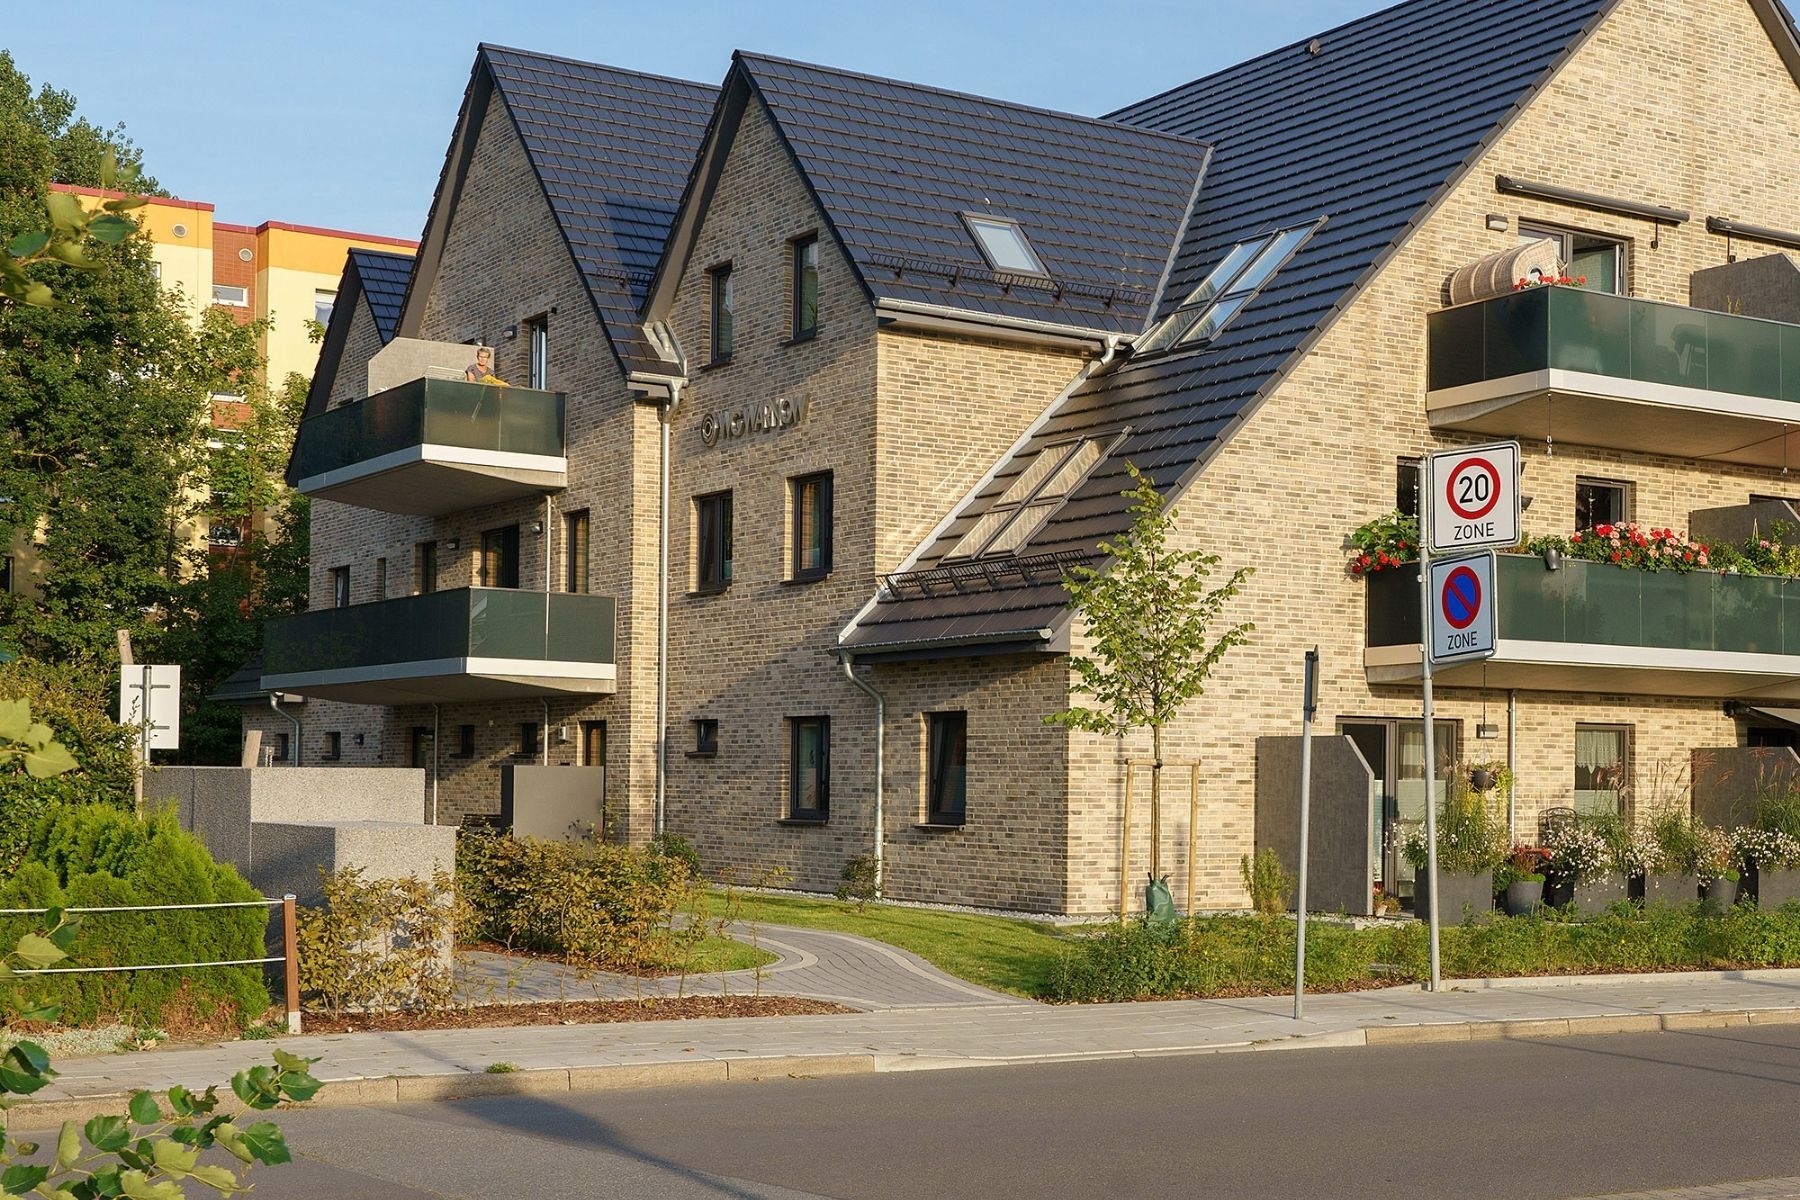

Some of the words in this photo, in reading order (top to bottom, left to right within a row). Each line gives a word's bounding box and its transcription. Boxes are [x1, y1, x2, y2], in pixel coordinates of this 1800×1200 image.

[1458, 473, 1489, 503] 20
[1453, 522, 1495, 541] ZONE
[1447, 631, 1478, 650] ZONE
